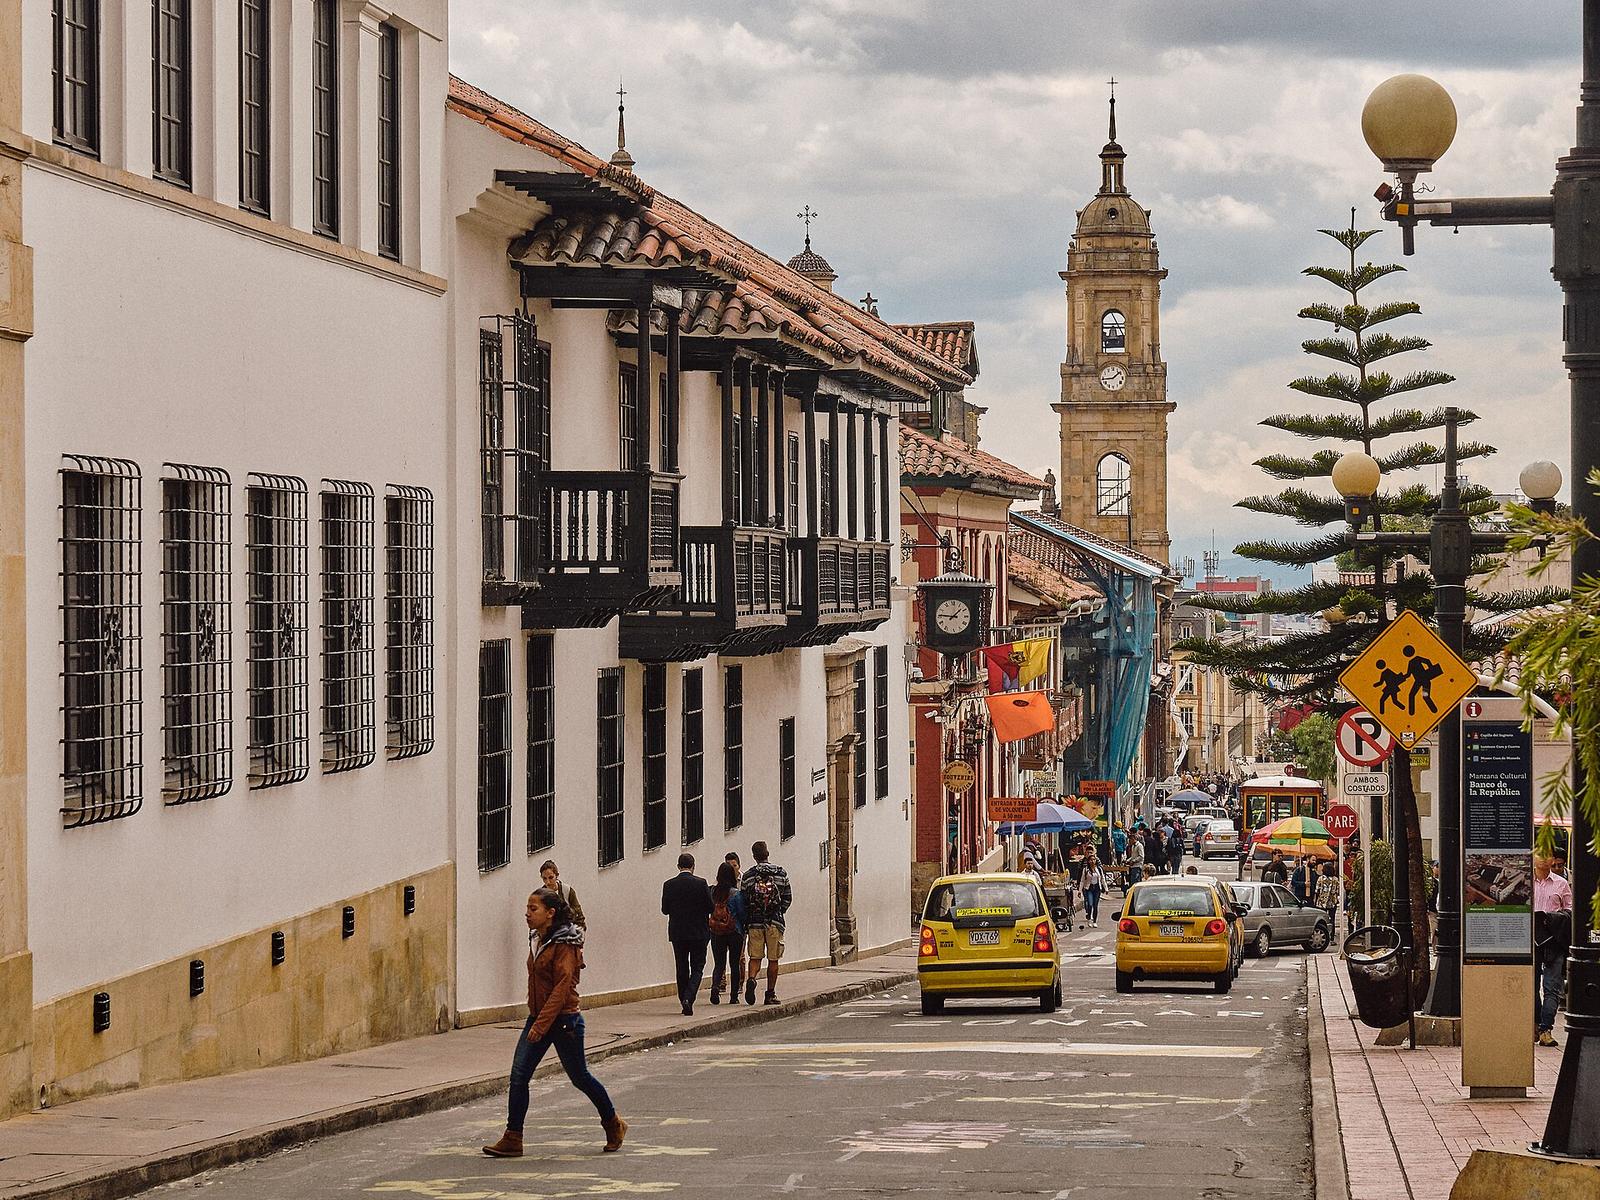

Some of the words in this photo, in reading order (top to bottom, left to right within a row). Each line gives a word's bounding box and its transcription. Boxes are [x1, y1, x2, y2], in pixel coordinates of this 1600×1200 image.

[1500, 772, 1527, 780] Cultural
[1469, 788, 1478, 796] la
[1479, 788, 1521, 797] República
[1327, 815, 1355, 828] PARE
